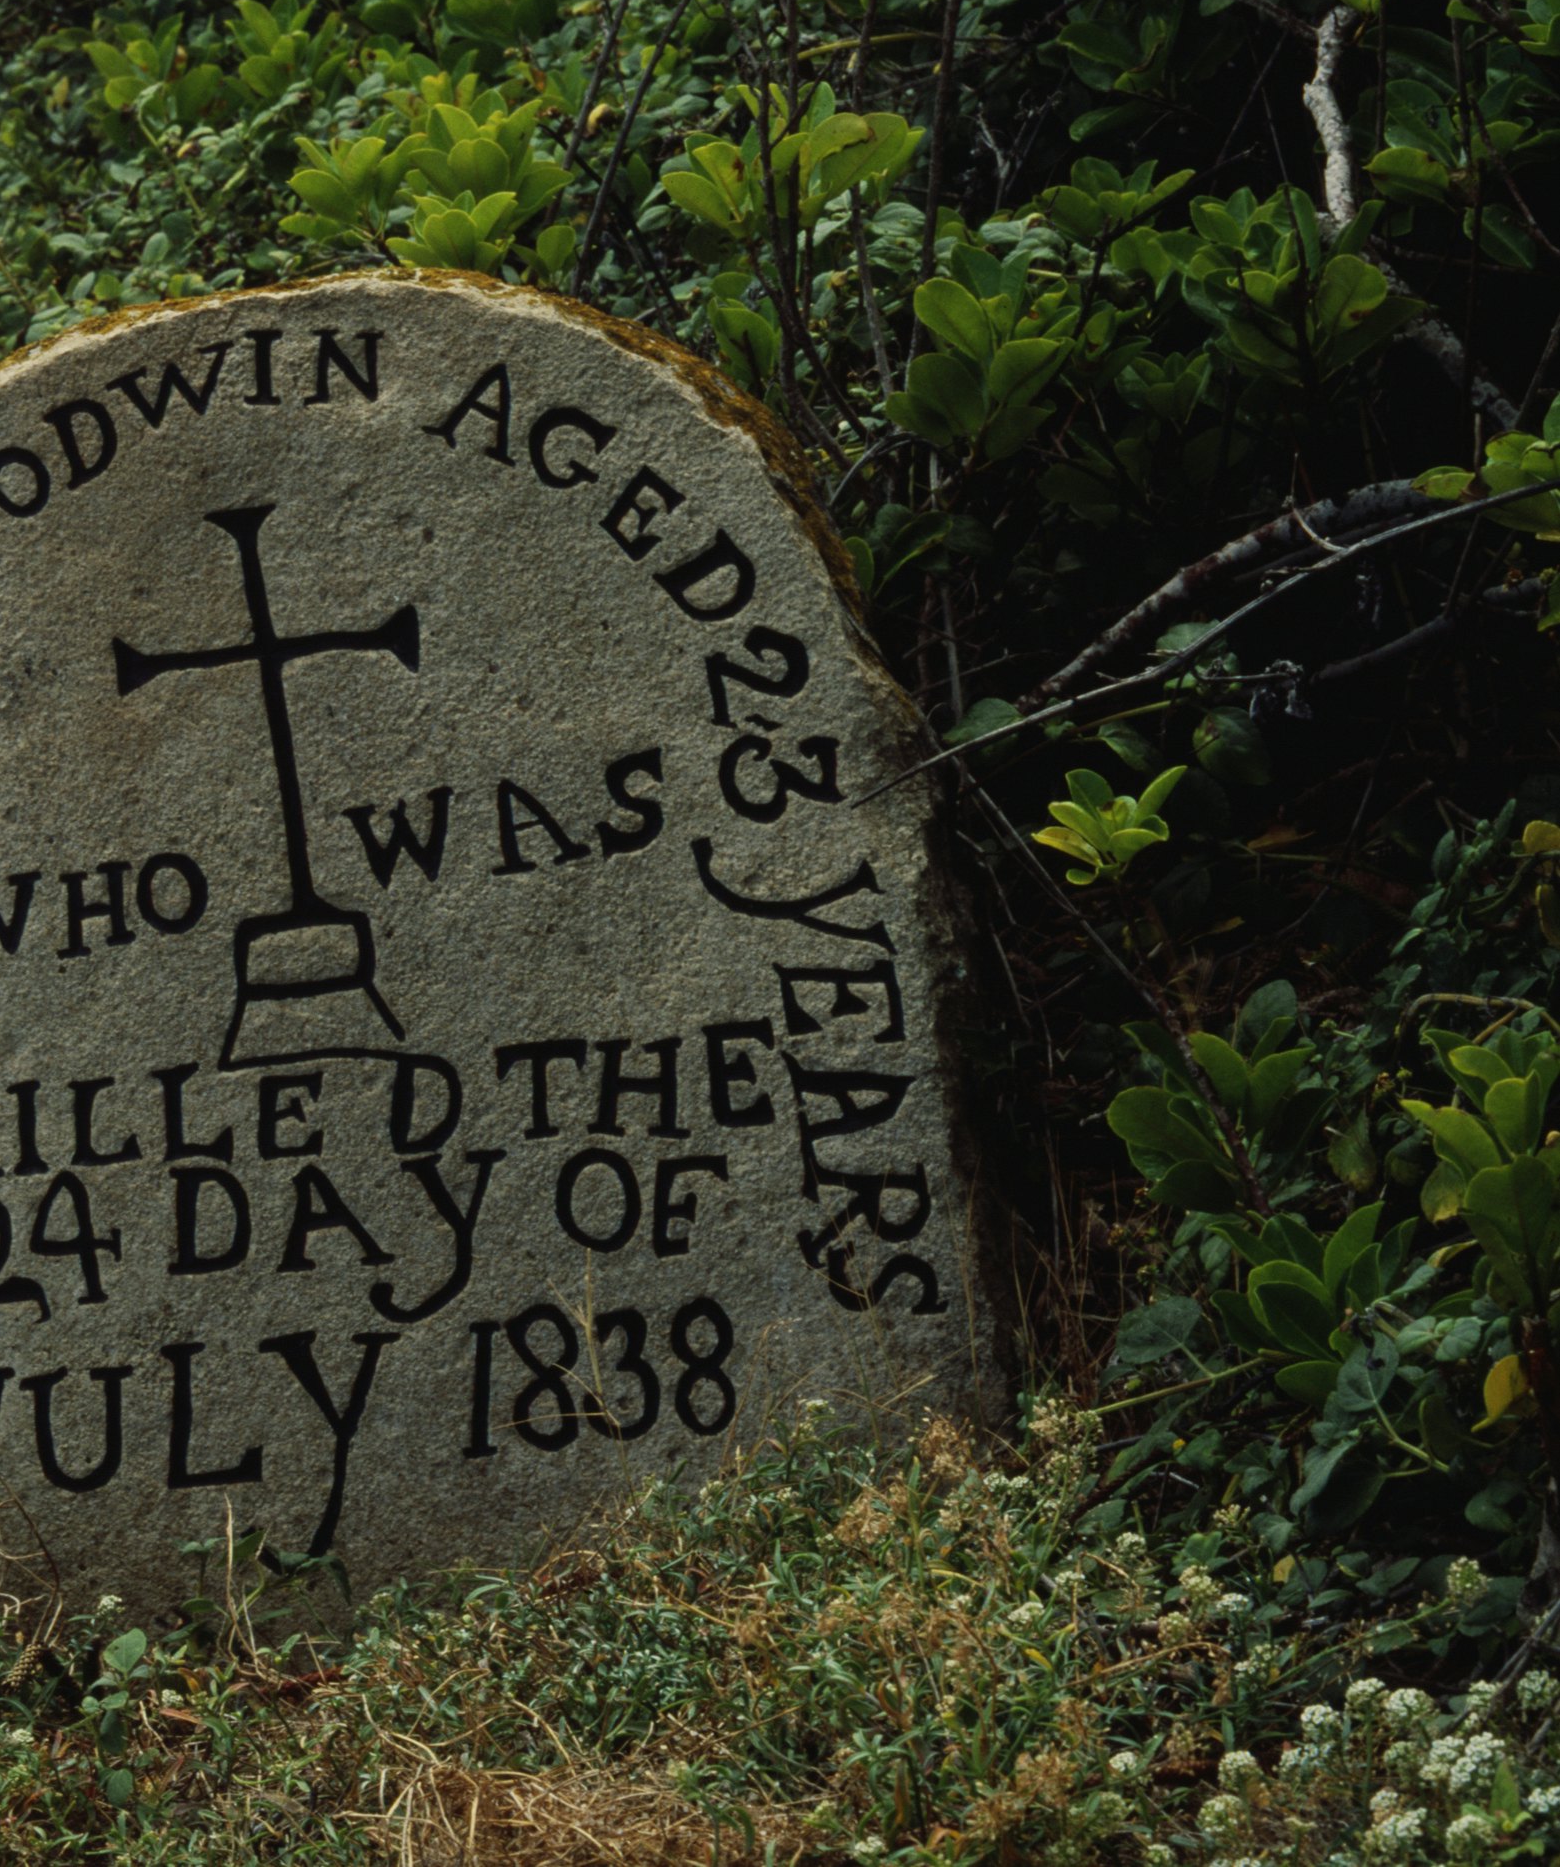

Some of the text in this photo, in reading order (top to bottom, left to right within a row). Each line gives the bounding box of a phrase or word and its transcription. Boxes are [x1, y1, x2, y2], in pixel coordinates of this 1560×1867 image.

[421, 362, 757, 622] AGED
[704, 624, 849, 825] 23
[341, 745, 666, 891] WAS
[494, 1016, 776, 1140] THE
[691, 836, 949, 1316] YEARS
[167, 1148, 508, 1325] DAY
[554, 1146, 729, 1258] OF
[461, 1296, 736, 1460] 1838
